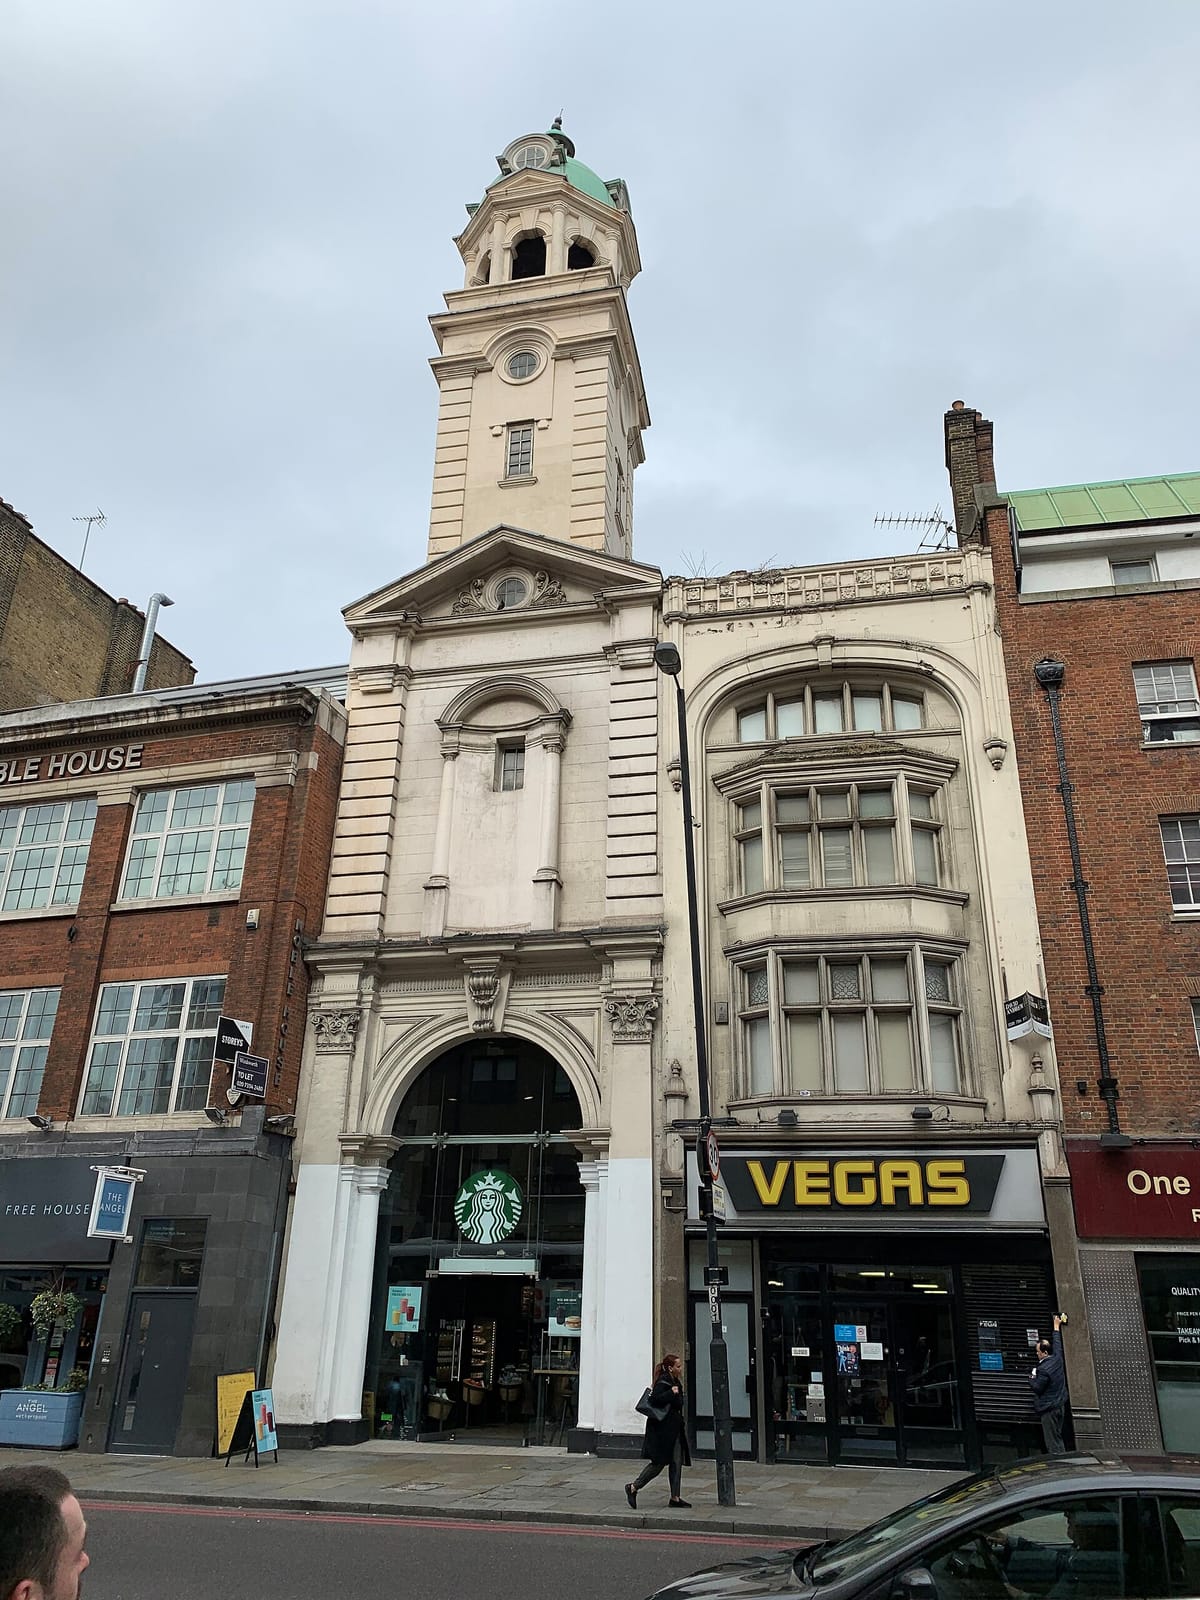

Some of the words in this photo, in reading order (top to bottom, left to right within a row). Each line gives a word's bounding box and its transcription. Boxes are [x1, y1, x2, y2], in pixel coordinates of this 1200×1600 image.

[47, 744, 144, 777] HOUSE
[237, 1071, 244, 1079] TO
[244, 1073, 254, 1081] LET
[746, 1159, 971, 1206] VEGAS
[1127, 1169, 1191, 1195] One
[107, 1192, 122, 1202] THE
[5, 1204, 36, 1216] FREE
[43, 1203, 91, 1215] HOUSE
[100, 1203, 126, 1214] ANGEL
[16, 1403, 48, 1413] ANGEL
